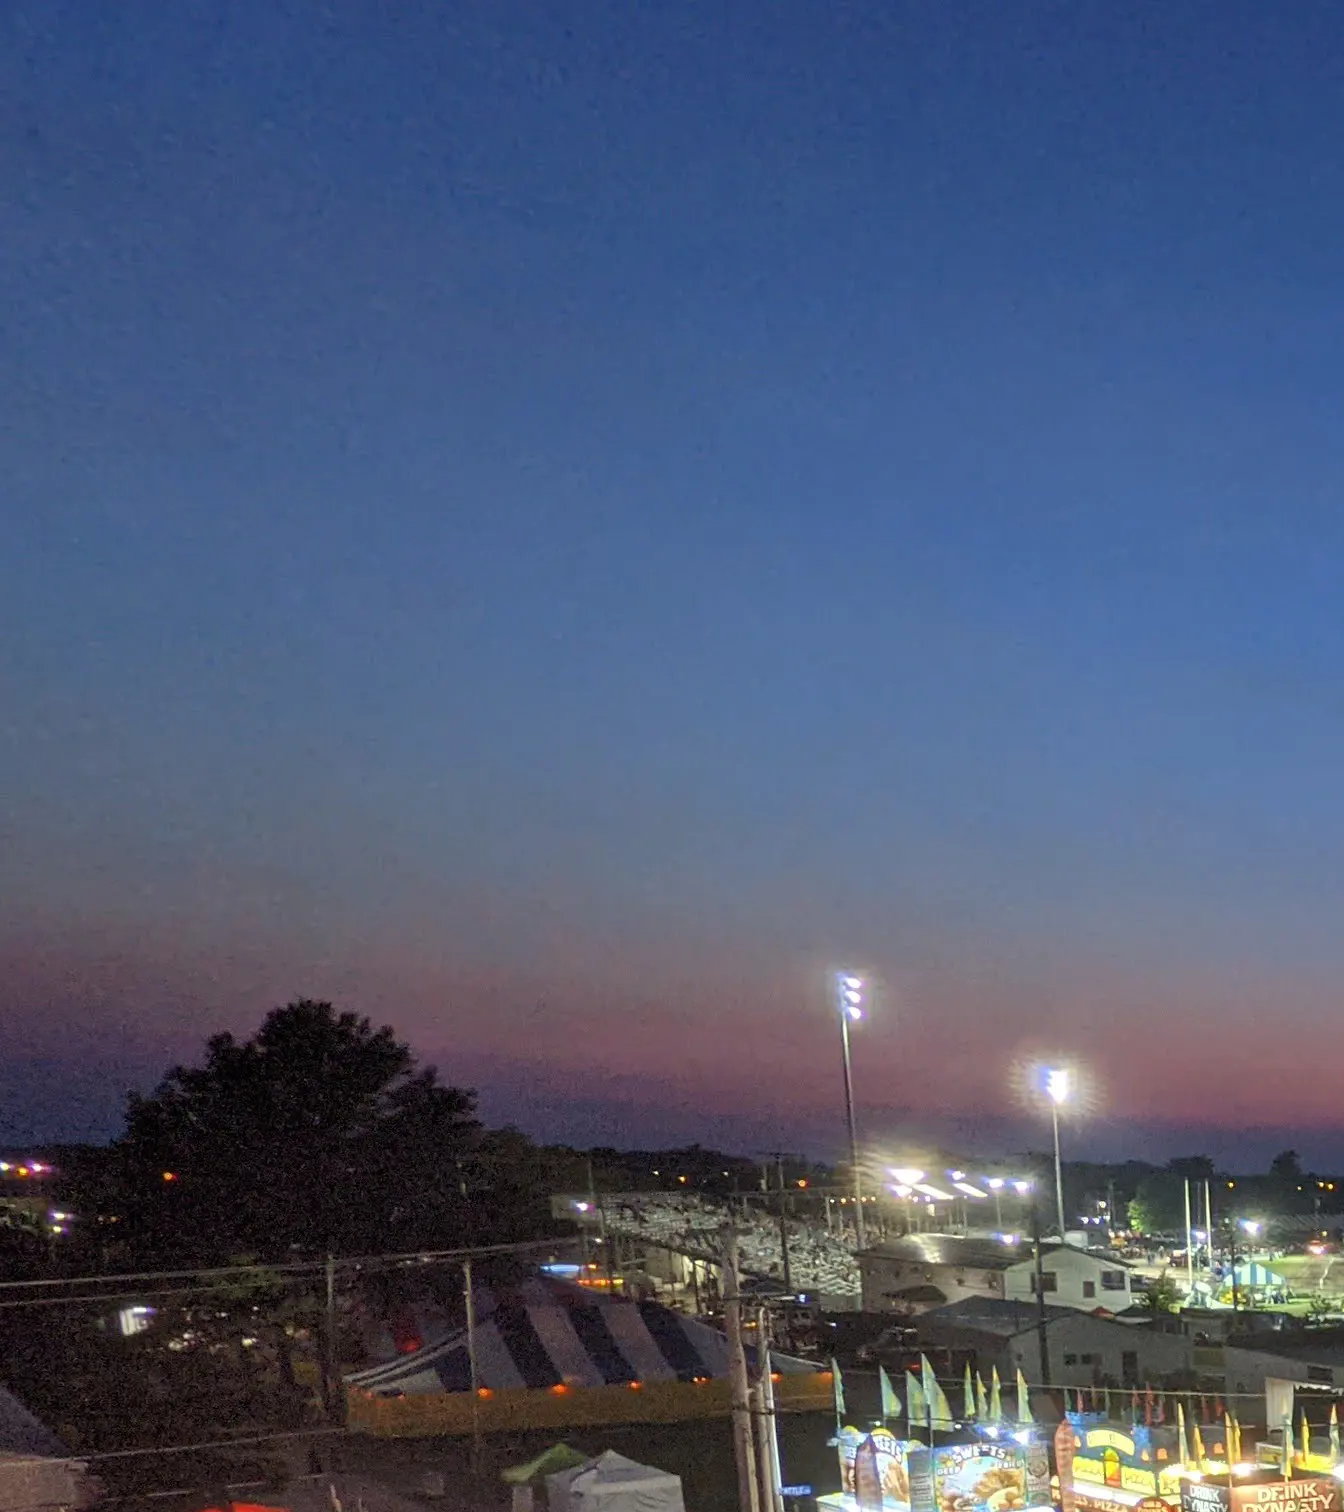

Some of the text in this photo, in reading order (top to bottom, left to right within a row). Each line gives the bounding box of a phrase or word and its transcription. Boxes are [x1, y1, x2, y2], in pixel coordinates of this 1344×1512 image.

[952, 1445, 1006, 1464] SWEETS
[1189, 1484, 1221, 1502] DRINK
[1258, 1482, 1318, 1503] DRINK
